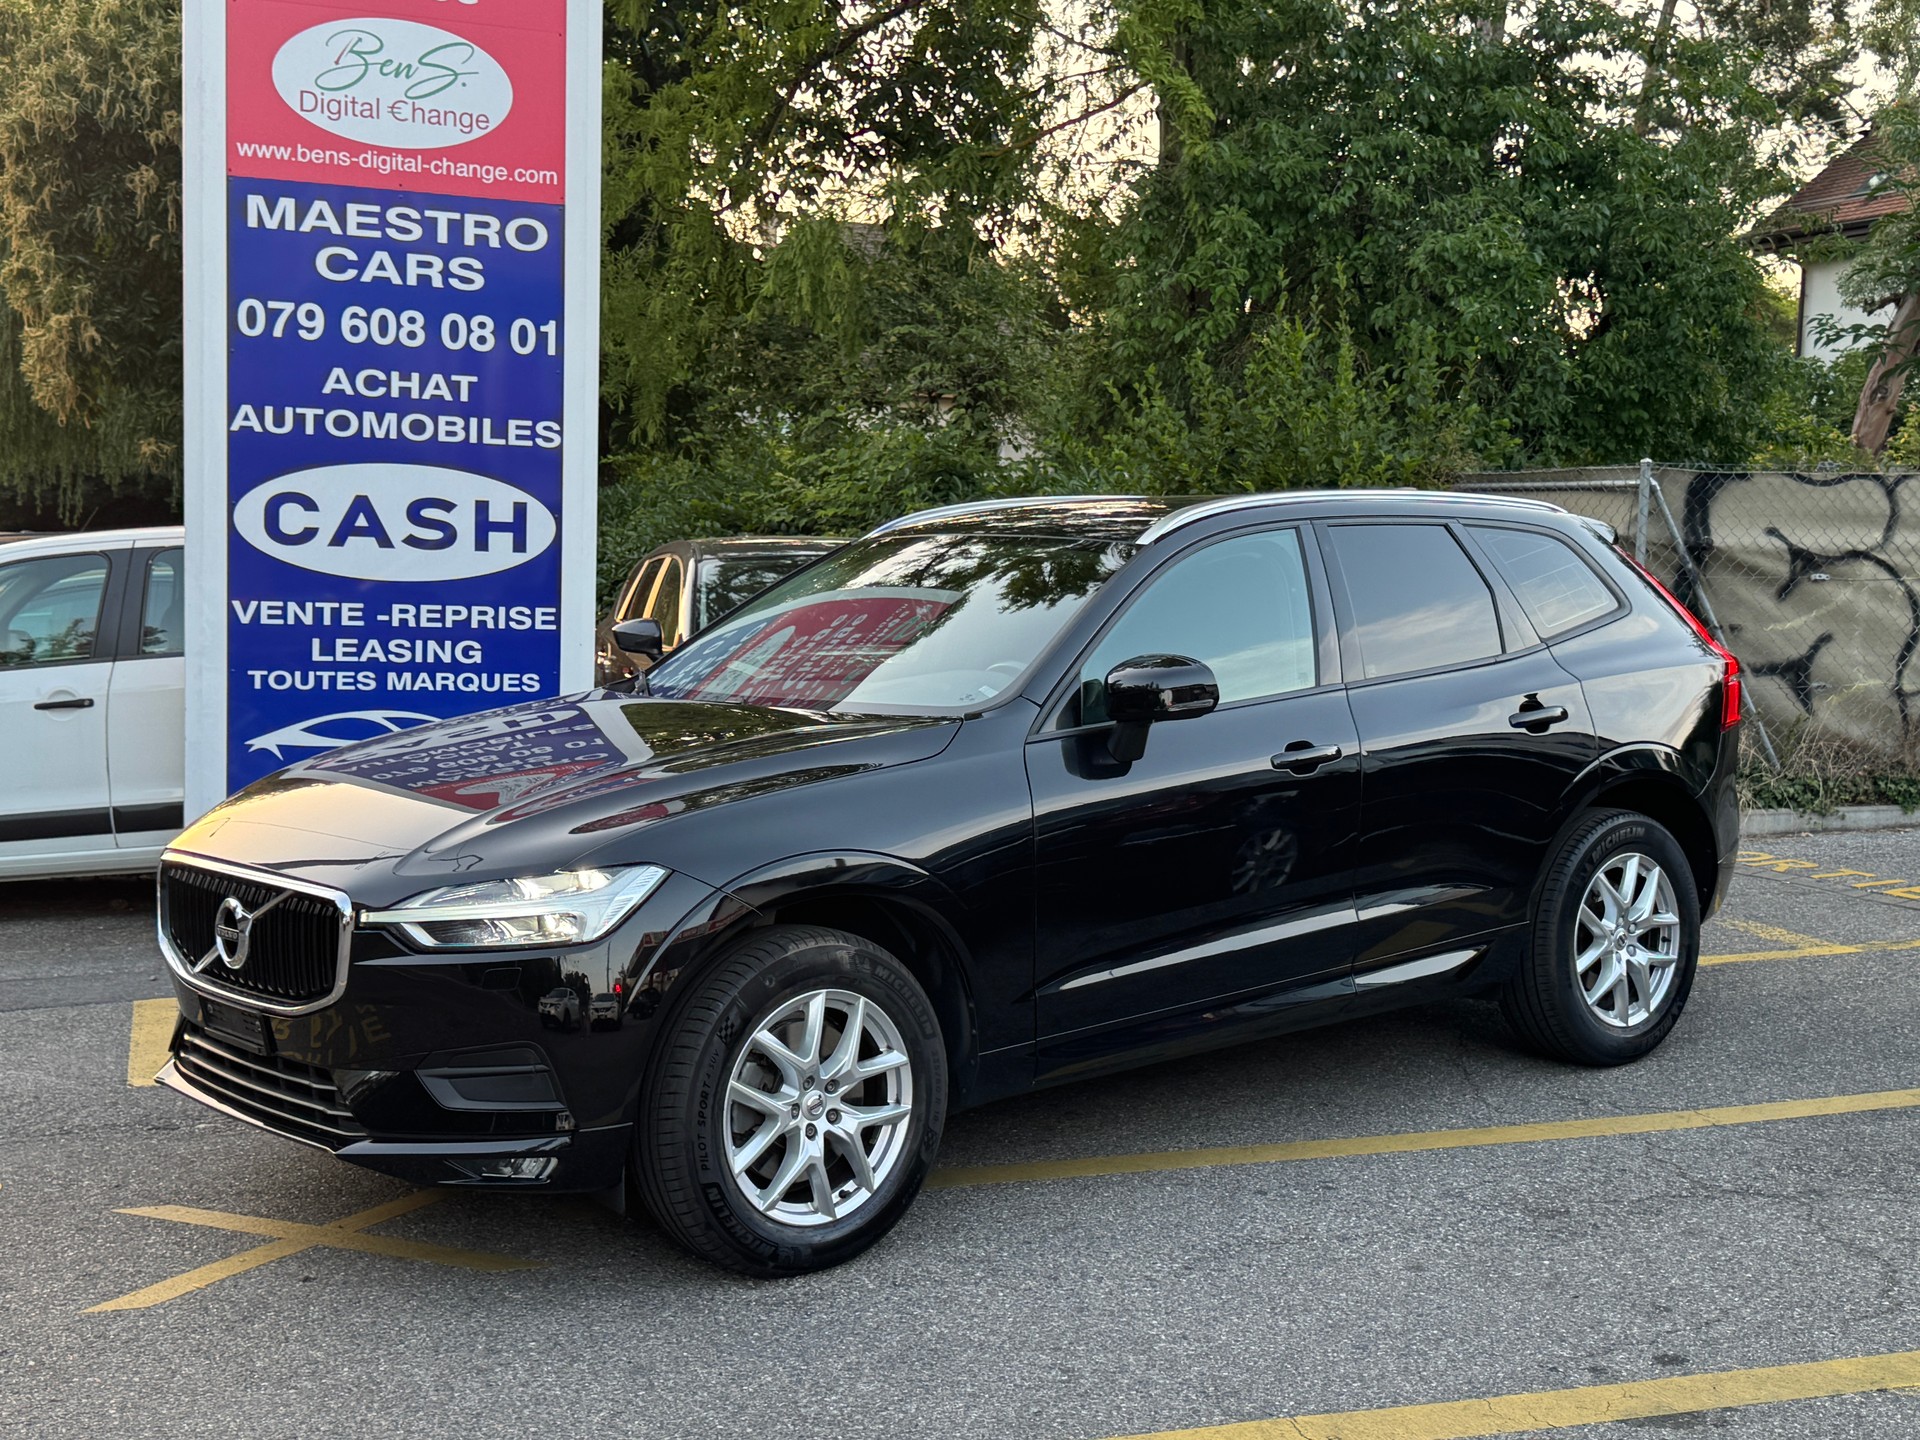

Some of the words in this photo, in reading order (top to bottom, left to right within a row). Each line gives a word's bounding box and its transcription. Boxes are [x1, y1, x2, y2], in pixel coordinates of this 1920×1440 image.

[299, 90, 381, 121] Digital
[236, 142, 558, 185] www.bens-digital-change.com
[247, 194, 549, 252] MAESTRO
[315, 246, 485, 291] CARS
[237, 298, 325, 341] 079
[341, 305, 426, 347] 608
[440, 312, 496, 352] 08
[510, 318, 557, 356] 01
[321, 367, 479, 402] ACHAT
[229, 404, 562, 448] AUTOMOBILES
[263, 491, 528, 554] CASH
[231, 600, 365, 626] VENTE
[376, 603, 557, 630] -REPRISE
[312, 638, 482, 664] LEASING
[247, 670, 377, 691] TOUTES
[387, 672, 540, 693] MARQUES
[1591, 826, 1646, 863] MICHELIN
[217, 926, 239, 941] VOLVO
[874, 965, 934, 1036] MICHELIN
[709, 1048, 720, 1069] SUV
[697, 1081, 711, 1127] SPORT
[697, 1133, 711, 1171] PILOT
[704, 1186, 776, 1257] MICHELIN
